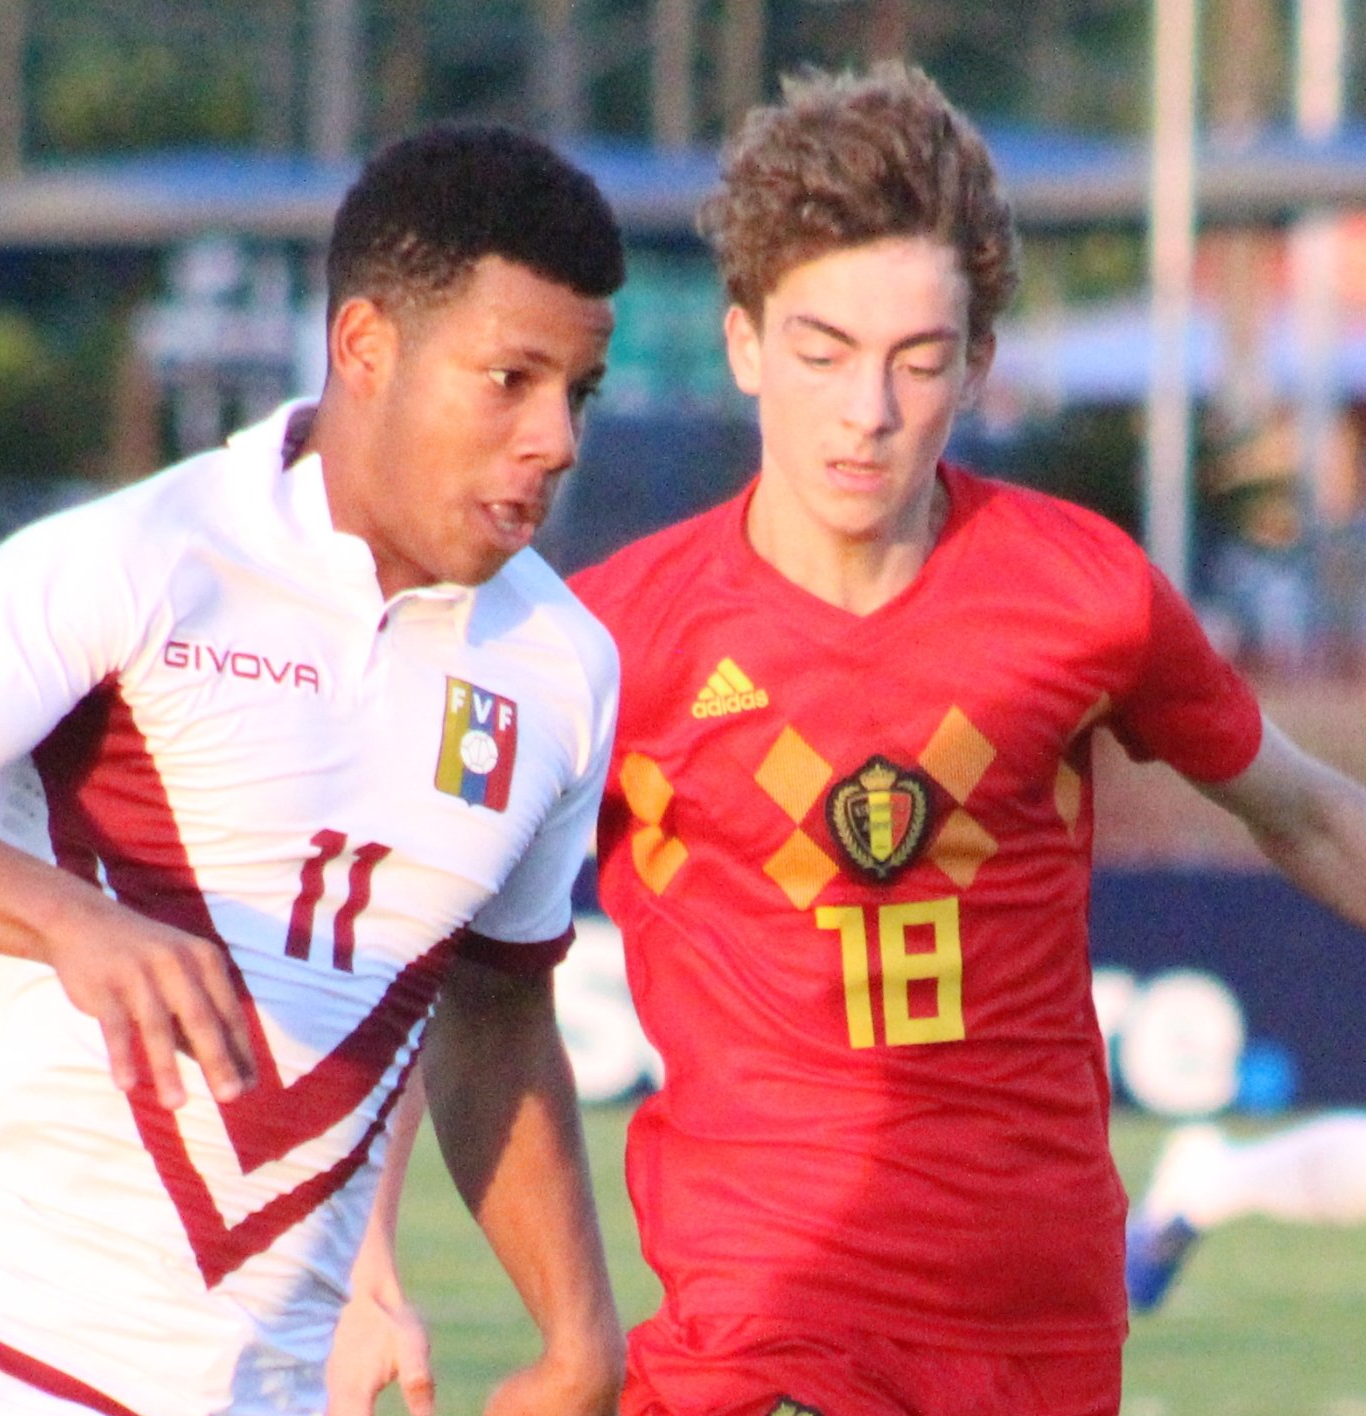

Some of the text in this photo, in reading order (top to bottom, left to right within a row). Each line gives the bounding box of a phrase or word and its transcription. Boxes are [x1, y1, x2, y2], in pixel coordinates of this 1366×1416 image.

[163, 640, 320, 693] GIVOVA
[450, 686, 513, 732] FVF
[691, 689, 769, 719] adidas
[285, 829, 393, 973] 11
[815, 896, 966, 1048] 18
